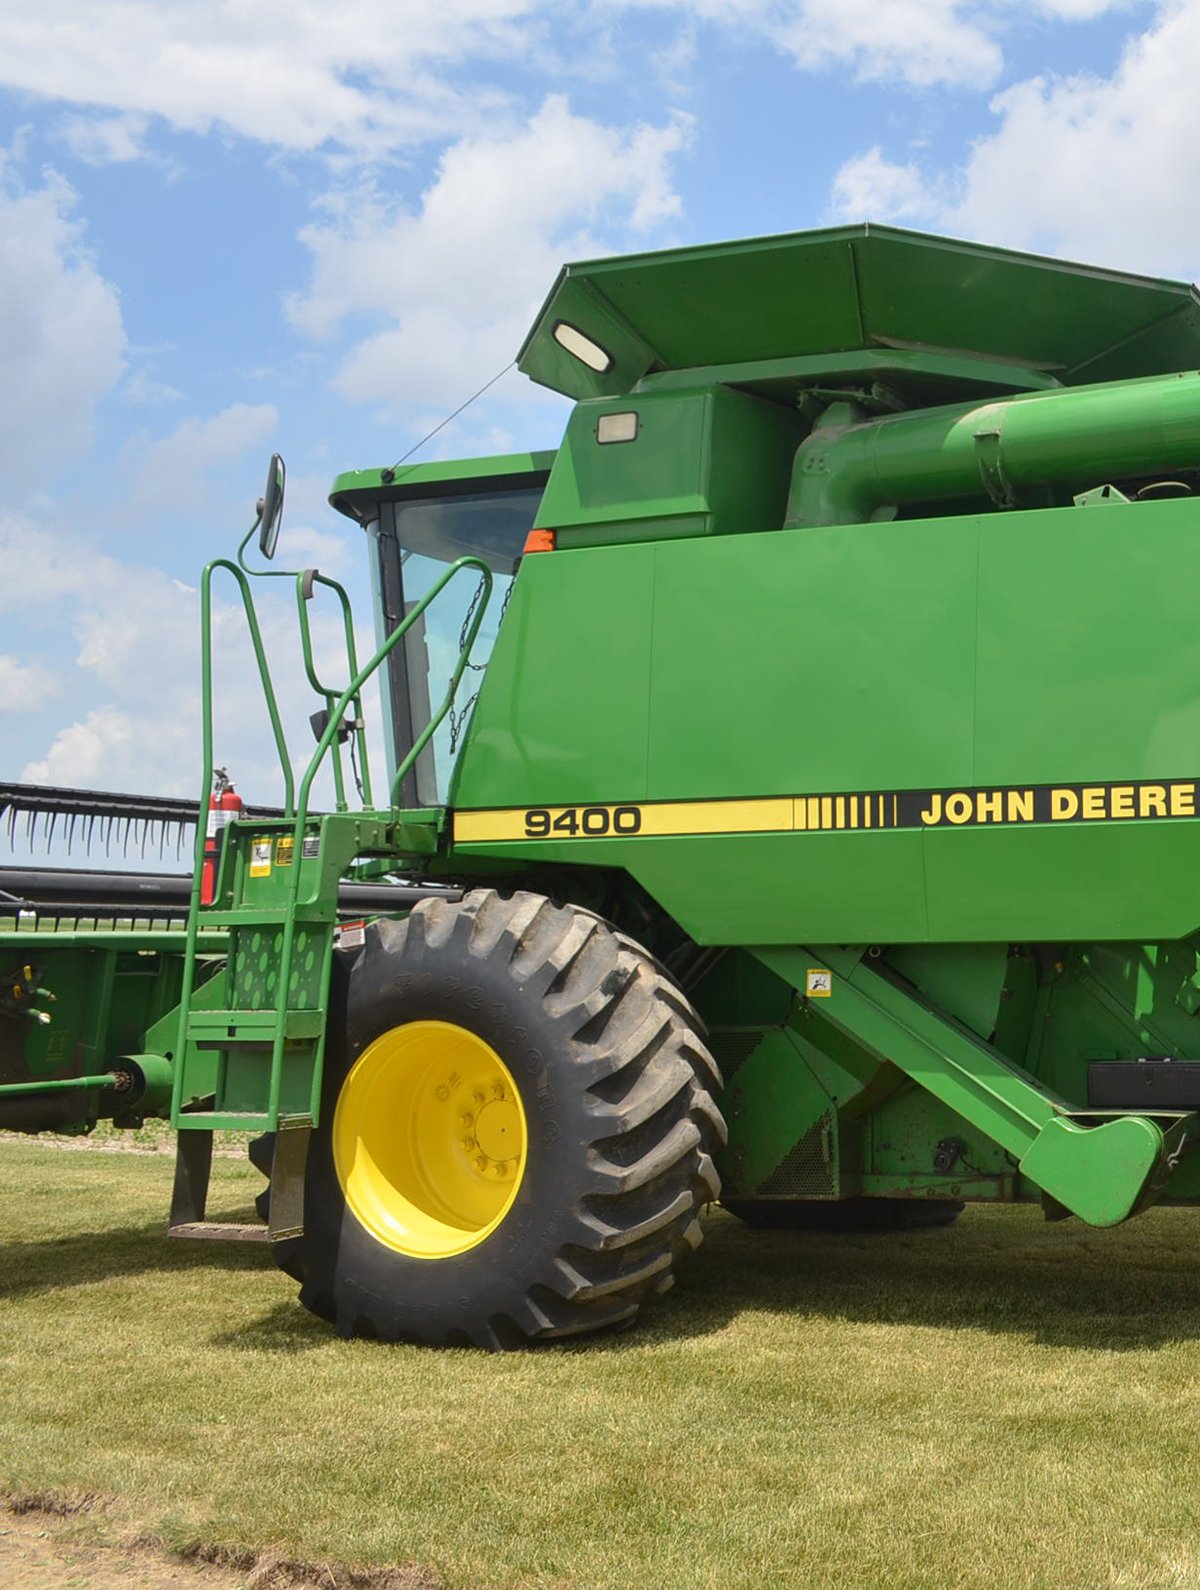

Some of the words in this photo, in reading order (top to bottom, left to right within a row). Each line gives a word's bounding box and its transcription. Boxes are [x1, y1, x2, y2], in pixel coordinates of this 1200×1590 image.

[524, 806, 642, 837] 9400
[921, 790, 1034, 825] JOHN
[1051, 784, 1196, 821] DEERE
